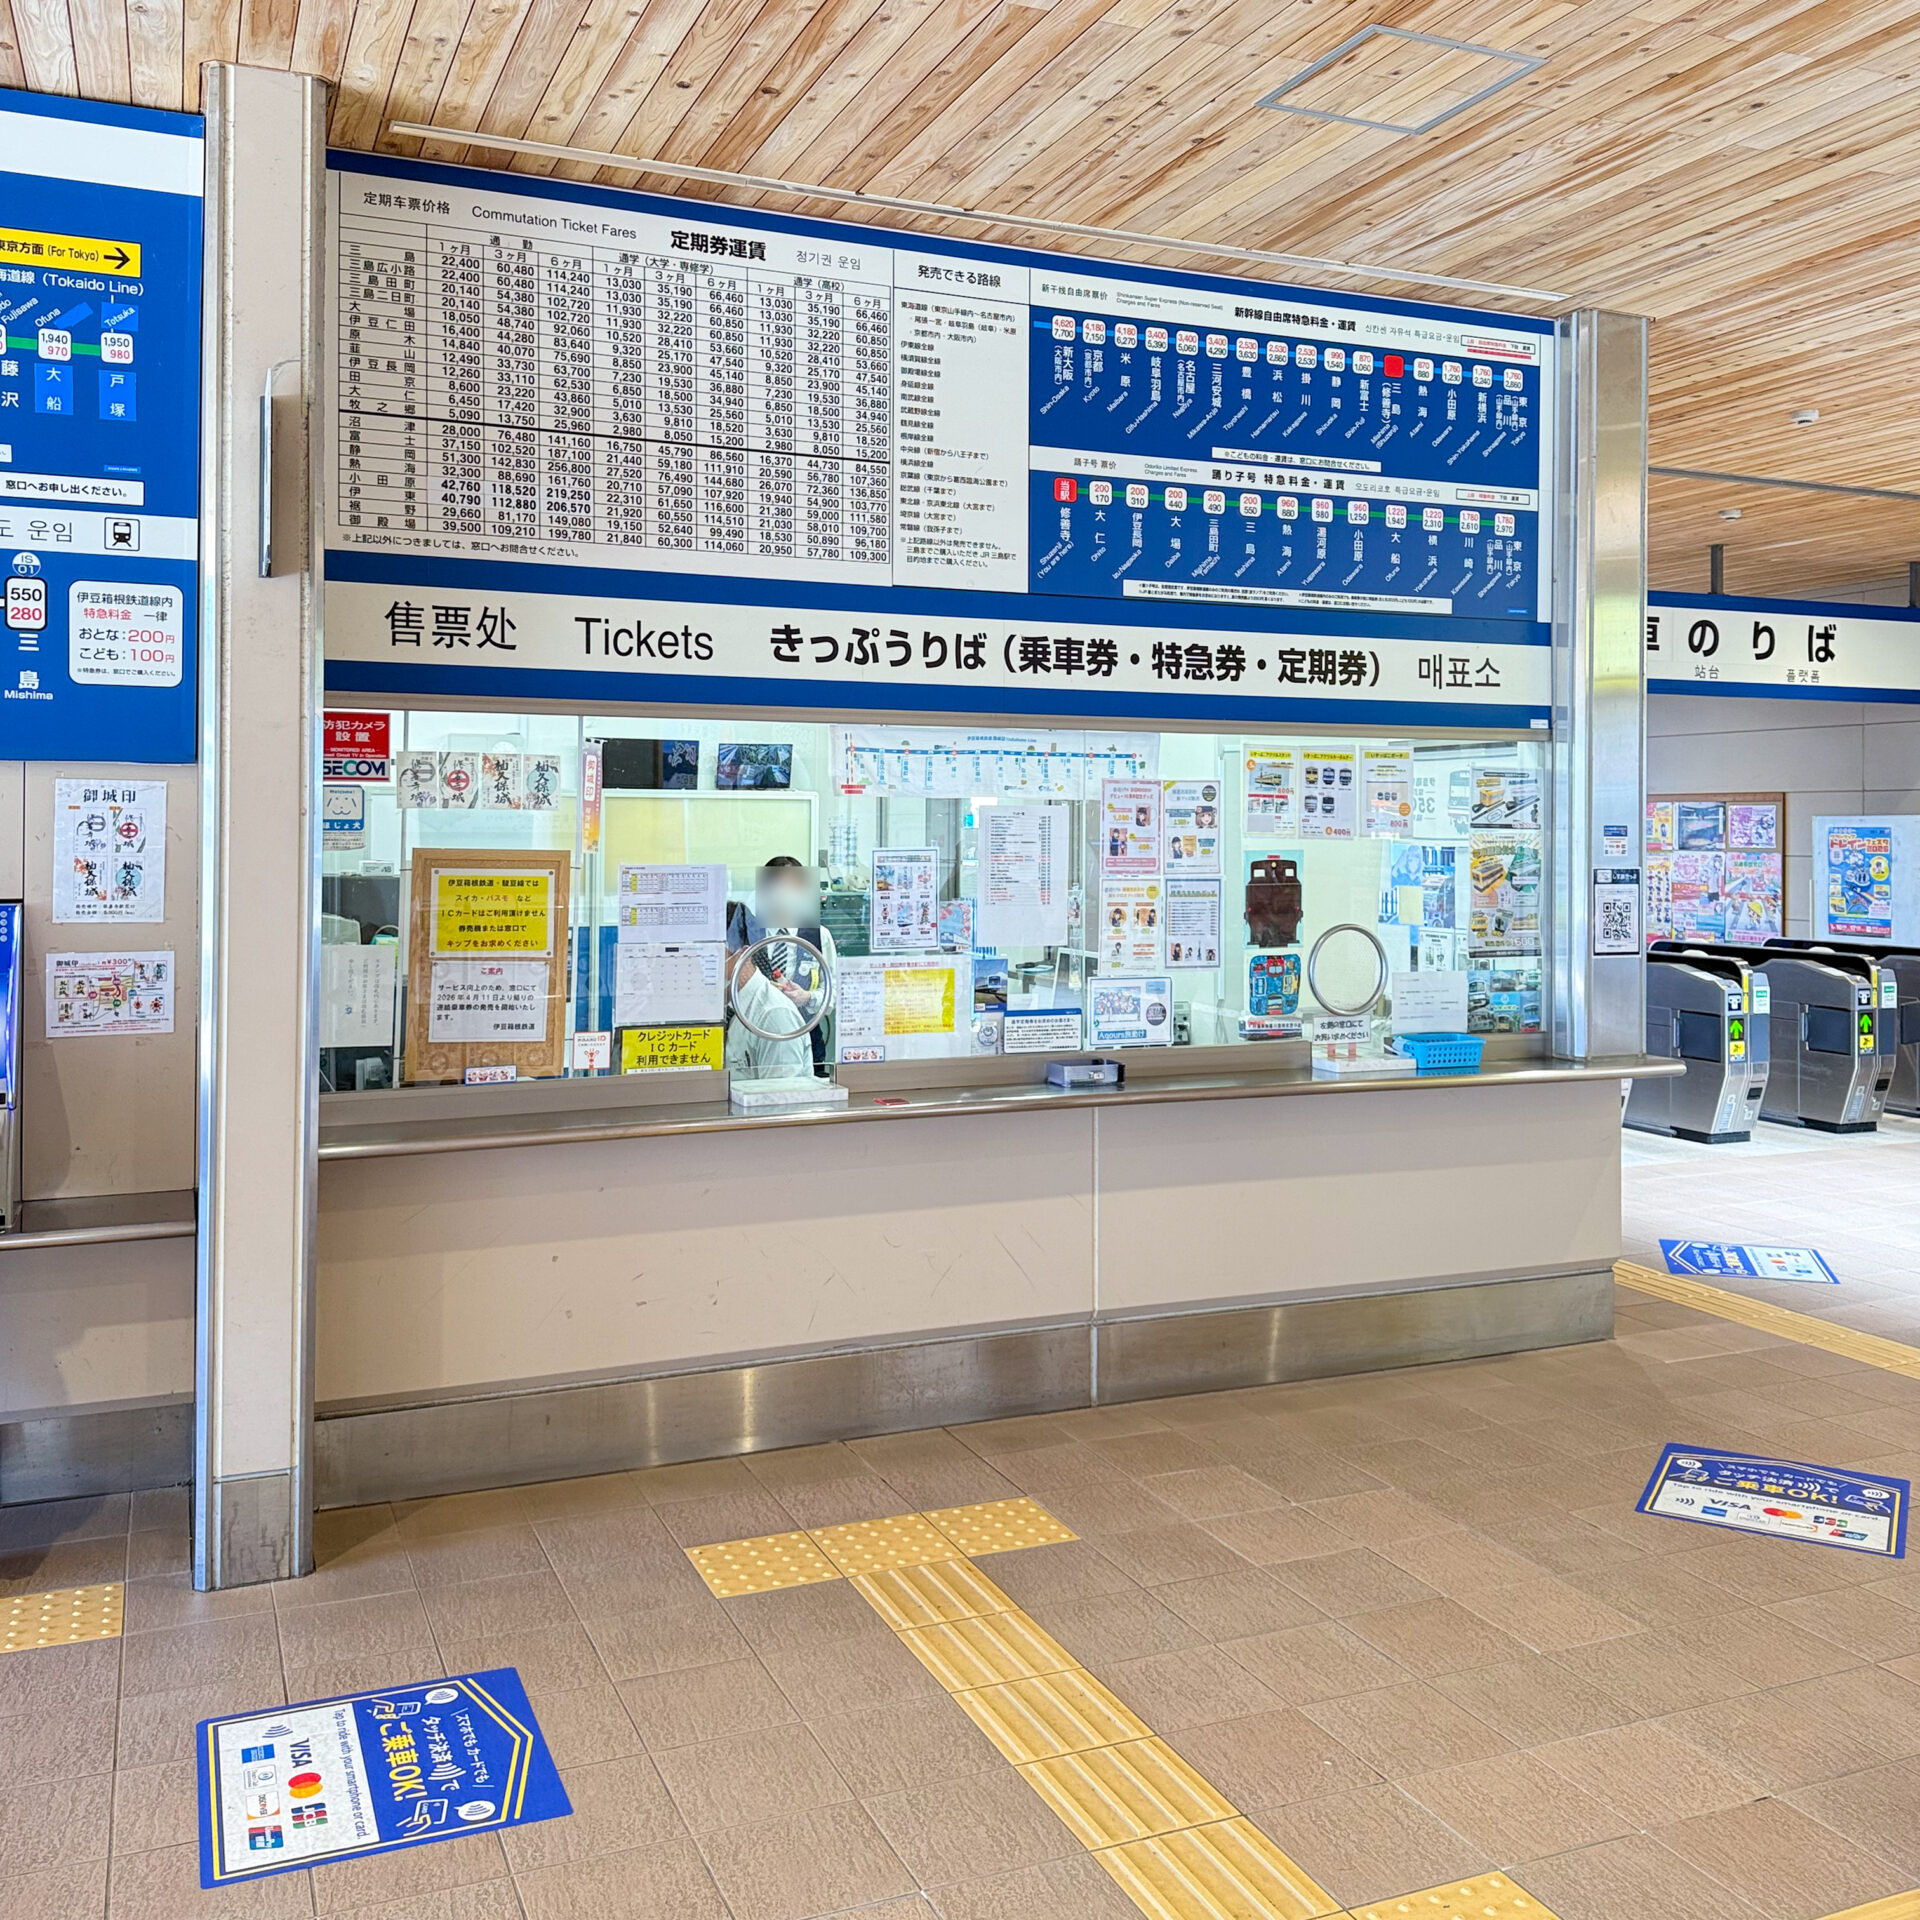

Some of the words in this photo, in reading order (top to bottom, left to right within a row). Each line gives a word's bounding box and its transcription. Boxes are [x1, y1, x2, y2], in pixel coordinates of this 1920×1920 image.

[363, 191, 451, 215] 定期车票价格
[471, 206, 557, 228] Commutation
[561, 219, 598, 234] Ticket
[601, 224, 637, 240] Fares
[47, 245, 66, 259] (For
[68, 247, 100, 262] Tokyo)
[670, 230, 766, 261] 定期券運賃
[350, 260, 416, 276] 三島広小路
[796, 250, 832, 266] 정기권
[837, 256, 861, 271] 운임
[918, 265, 1001, 288] 発売できる路線
[43, 273, 105, 292] (Tokaido
[109, 280, 145, 297] Line)
[441, 255, 480, 269] 22,400
[496, 263, 535, 276] 60,480
[547, 269, 590, 283] 114,240
[606, 277, 642, 290] 13,030
[657, 283, 692, 297] 35,190
[709, 290, 744, 303] 66,460
[760, 297, 793, 310] 13,030
[807, 303, 840, 316] 35,190
[855, 309, 888, 322] 66,460
[350, 288, 415, 304] 三島二日町
[1, 297, 39, 325] Fujisawa
[34, 308, 61, 328] Ofuna
[104, 306, 136, 328] Totsuka
[1234, 306, 1356, 332] 新幹線自由席特急料金・運賃
[442, 310, 480, 324] 18,050
[497, 317, 535, 331] 48,740
[553, 324, 590, 337] 92,060
[41, 333, 68, 345] 1,940
[103, 337, 130, 348] 1,950
[47, 346, 68, 357] 970
[110, 349, 130, 360] 980
[1063, 346, 1074, 381] 新大阪
[45, 367, 62, 411] 大船
[109, 373, 126, 418] 戸塚
[1082, 386, 1100, 404] Kyoto
[442, 424, 481, 438] 28,000
[497, 429, 536, 442] 76,480
[548, 435, 591, 448] 141,160
[759, 455, 793, 467] 16,370
[807, 460, 840, 471] 44,730
[855, 464, 887, 475] 84,550
[1212, 469, 1256, 483] 踊り子号
[1264, 474, 1345, 491] 特急料金・運賃
[5, 480, 128, 498] 窓口へお申し出ください。
[441, 480, 481, 492] 42,760
[491, 484, 536, 497] 118,520
[546, 488, 591, 501] 219,250
[1095, 494, 1110, 503] 170
[1130, 497, 1145, 506] 310
[1168, 500, 1183, 509] 440
[1243, 506, 1257, 515] 550
[27, 520, 73, 543] 운임
[1461, 522, 1479, 531] 2,610
[1496, 525, 1513, 534] 2,970
[442, 521, 482, 534] 39,500
[491, 525, 536, 537] 109,210
[548, 529, 592, 541] 199,780
[606, 533, 643, 545] 21,840
[657, 536, 693, 549] 60,300
[704, 539, 744, 552] 114,060
[759, 543, 793, 556] 20,950
[807, 547, 840, 559] 57,780
[849, 550, 887, 562] 109,300
[21, 554, 33, 564] IS
[18, 564, 35, 575] 01
[10, 588, 42, 601] 550
[77, 592, 173, 607] 伊豆箱根鉄道線内
[10, 608, 42, 621] 280
[83, 608, 132, 620] 特急料金
[144, 611, 168, 622] 一律
[384, 600, 518, 652] 售票处
[574, 616, 714, 663] Tickets
[18, 633, 40, 689] 三島
[1418, 652, 1501, 692] 매표소
[1694, 665, 1720, 680] 站台
[1786, 668, 1820, 684] 플랫폼
[4, 689, 53, 700] Mishima
[335, 731, 371, 742] 設置
[323, 760, 386, 776] SECOM
[83, 789, 136, 804] 御城印
[517, 894, 531, 902] など
[458, 924, 527, 933] 券売機または窓口で
[446, 939, 538, 948] キップをお求めください
[480, 967, 504, 976] ご案内
[493, 1023, 535, 1031] 伊豆箱根鉄道
[637, 1029, 711, 1042] クレジットカード
[636, 1054, 711, 1066] 利用できません
[1709, 1498, 1752, 1511] VISA
[332, 1708, 346, 1720] Tap
[336, 1720, 346, 1728] to
[338, 1728, 351, 1740] ride
[421, 1716, 453, 1764] タッチ決済
[289, 1737, 313, 1769] VISA
[340, 1740, 354, 1755] with
[339, 1755, 354, 1770] your
[345, 1770, 362, 1812] smartphone
[352, 1811, 364, 1820] or
[354, 1820, 371, 1840] card.
